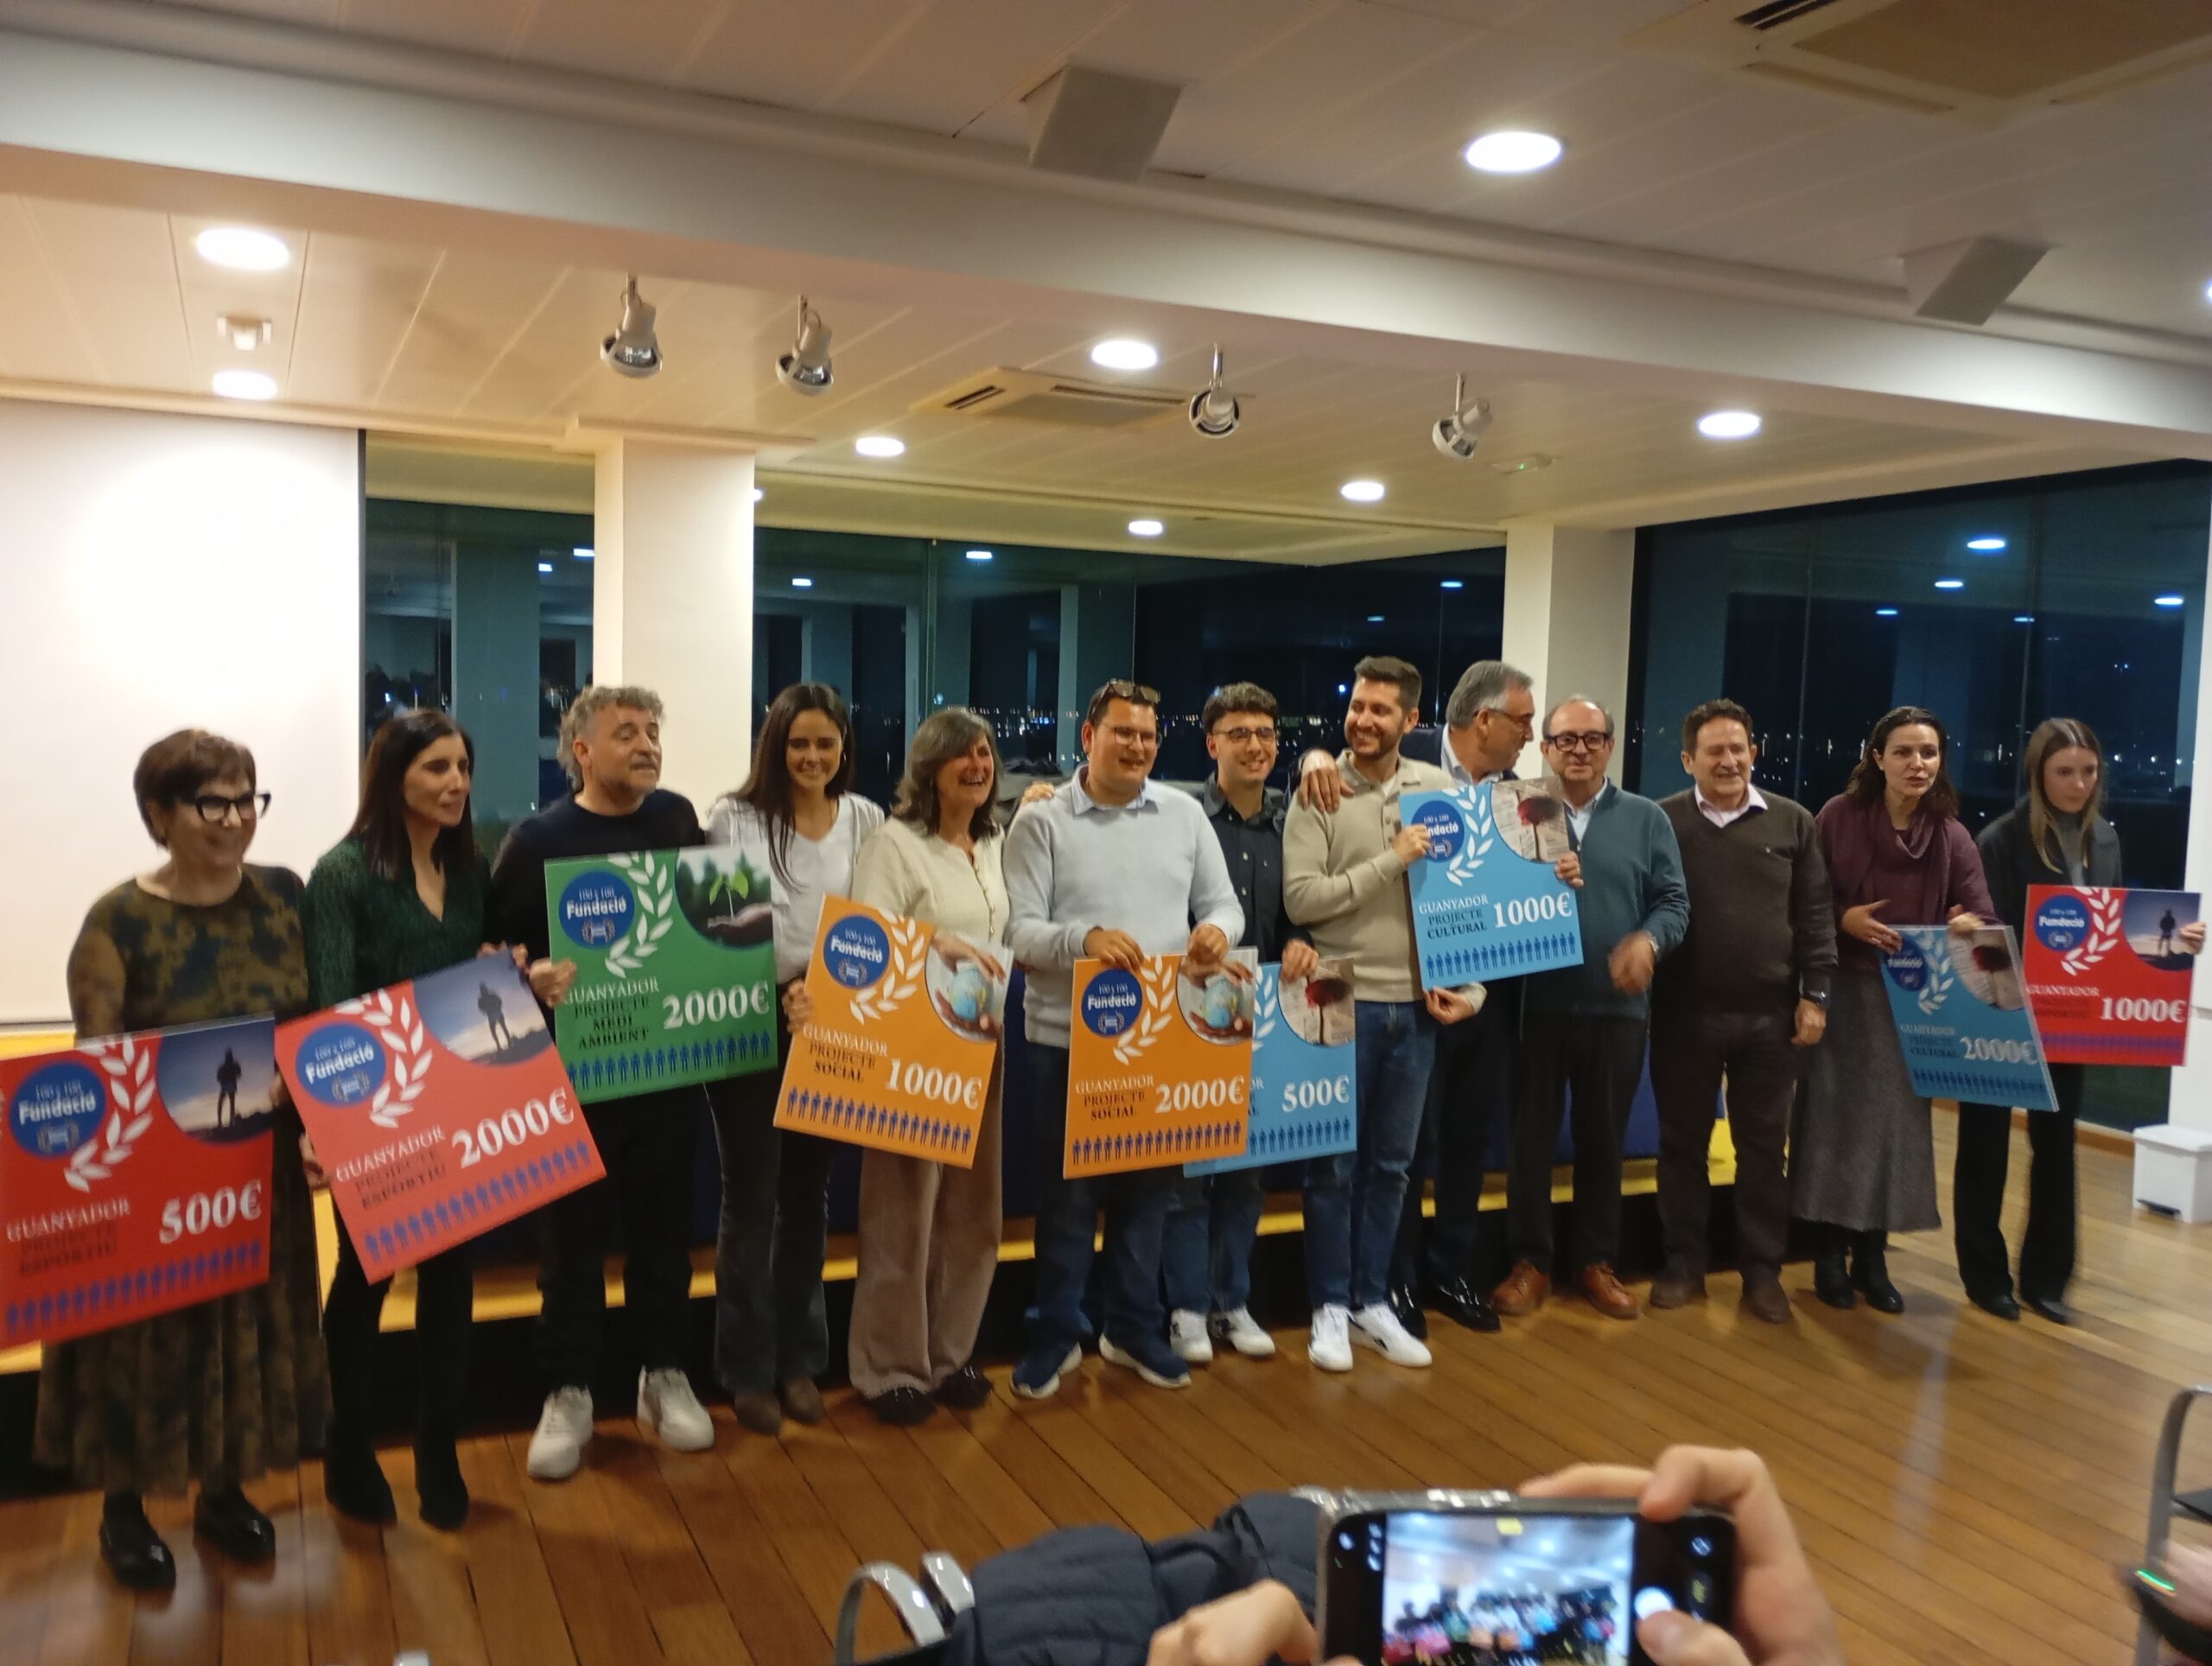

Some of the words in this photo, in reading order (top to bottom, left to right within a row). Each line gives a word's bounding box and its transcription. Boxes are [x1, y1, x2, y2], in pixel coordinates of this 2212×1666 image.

[1427, 820, 1459, 837] ndació
[567, 895, 626, 920] Fundació
[1419, 893, 1489, 914] GUANYADOR
[1428, 908, 1484, 926] PROJECTE
[1492, 892, 1573, 929] 1000€
[1427, 921, 1487, 940] CULTURAL
[662, 980, 770, 1030] 2000€
[1087, 991, 1137, 1011] Fundació
[2101, 996, 2188, 1024] 1000€
[803, 1023, 888, 1058] GUANYADOR
[810, 1040, 876, 1071] PROJECTE
[1959, 1036, 2040, 1066] 2000€
[305, 1041, 374, 1085] Fundació
[814, 1059, 863, 1084] SOCIAL
[885, 1058, 982, 1111] 1000€
[1075, 1074, 1154, 1096] GUANYADOR
[1084, 1088, 1146, 1108] PROJECTE
[1154, 1075, 1245, 1114] 2000€
[1281, 1074, 1351, 1113] 500€
[18, 1089, 97, 1127] Fundació
[1090, 1103, 1137, 1122] SOCIAL
[451, 1086, 575, 1169] 2000€
[335, 1123, 446, 1182] GUANYADOR
[6, 1196, 130, 1243] GUANYADOR
[159, 1180, 263, 1245] 500€
